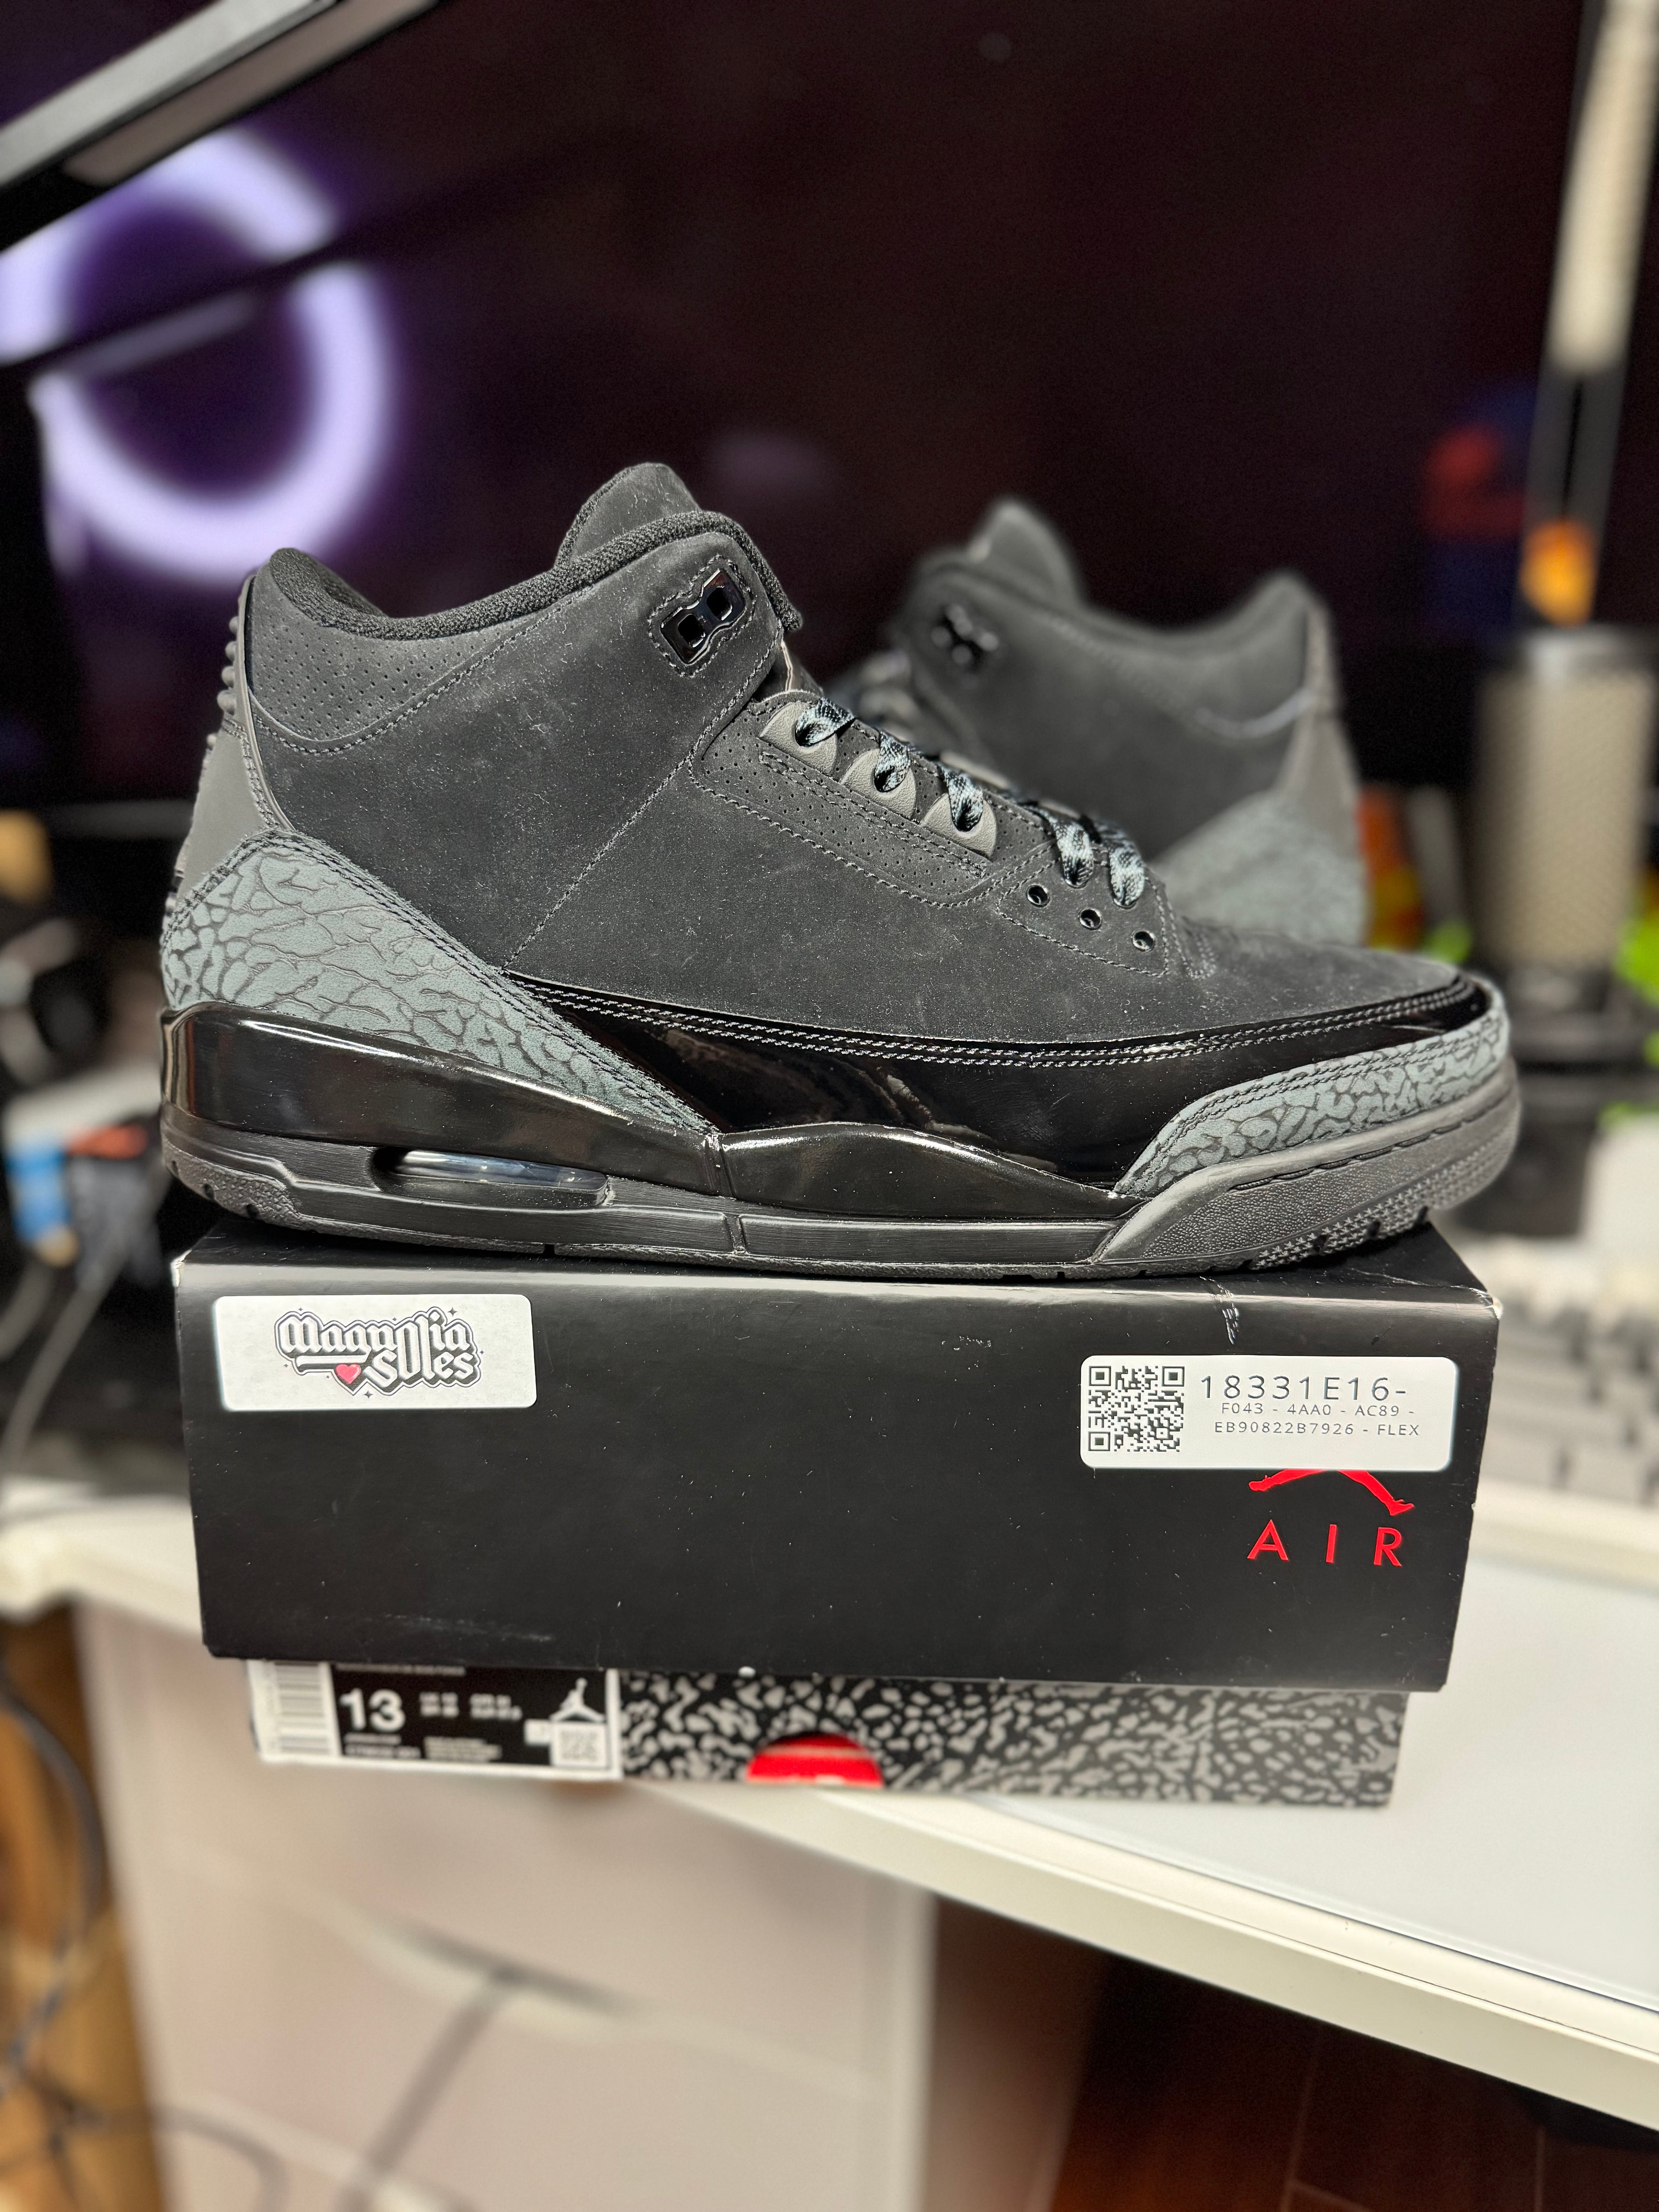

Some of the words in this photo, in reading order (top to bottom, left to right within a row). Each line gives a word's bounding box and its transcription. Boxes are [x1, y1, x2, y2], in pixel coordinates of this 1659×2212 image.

[277, 1310, 474, 1365] Magnolia
[1201, 1375, 1406, 1401] 18331E16-
[1221, 1402, 1263, 1414] F043
[1355, 1405, 1399, 1417] AC89
[1215, 1421, 1354, 1435] EB90822B7926
[1377, 1424, 1420, 1436] FLEX
[1246, 1519, 1403, 1567] AIR
[340, 1688, 405, 1732] 13
